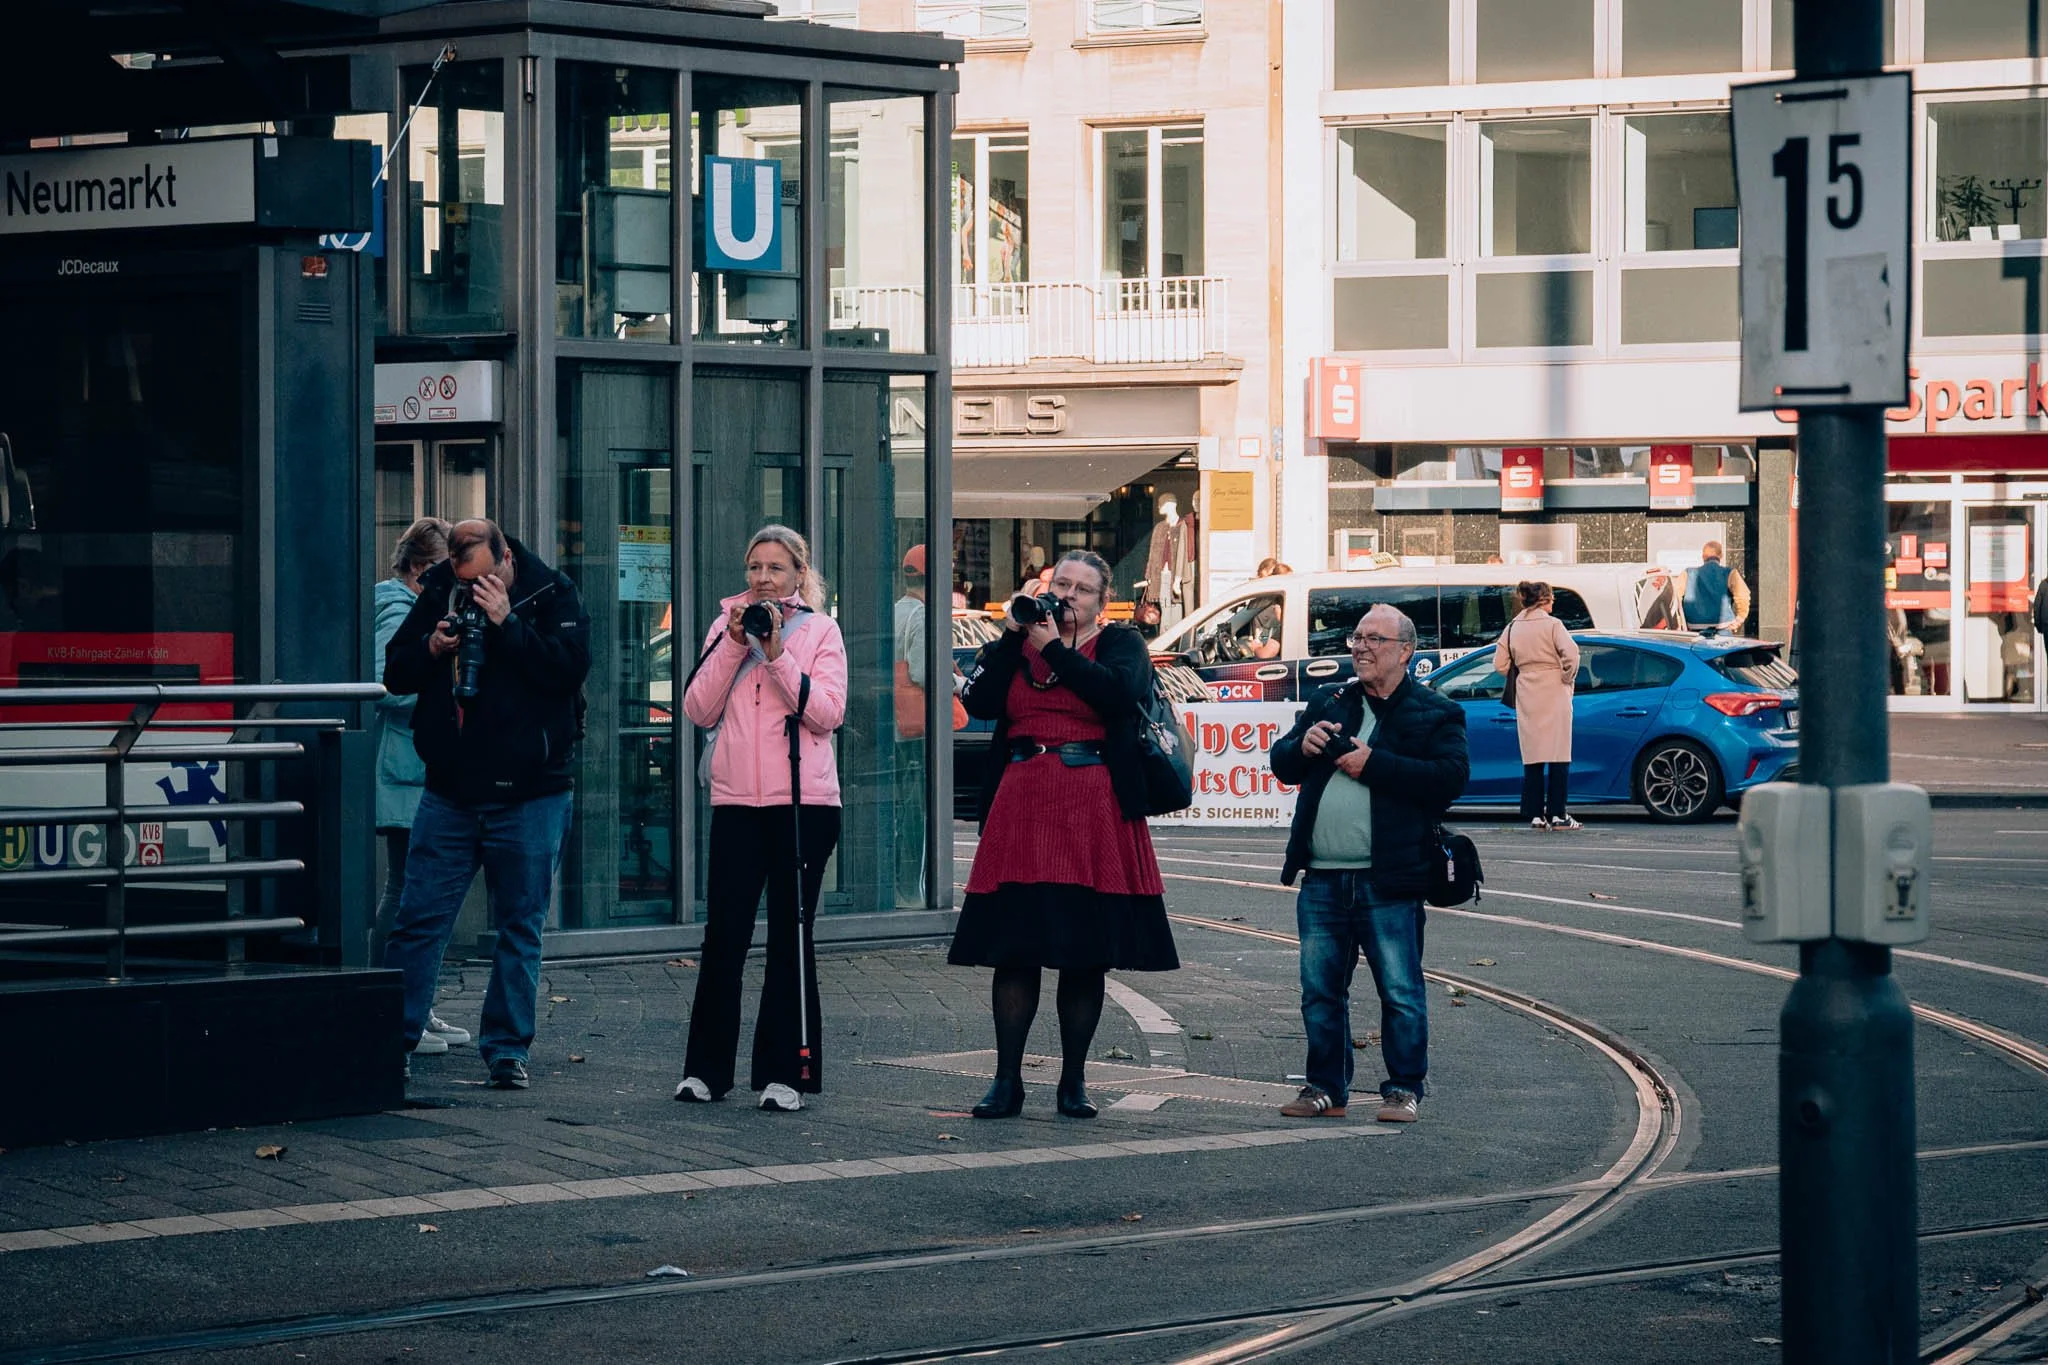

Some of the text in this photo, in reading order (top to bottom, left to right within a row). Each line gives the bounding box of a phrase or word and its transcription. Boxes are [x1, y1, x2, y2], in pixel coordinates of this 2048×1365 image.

[6, 163, 177, 217] Neumarkt
[712, 162, 775, 261] U
[57, 259, 120, 276] JCDecaux
[1207, 807, 1279, 819] SICHERN!
[142, 823, 161, 841] KVB
